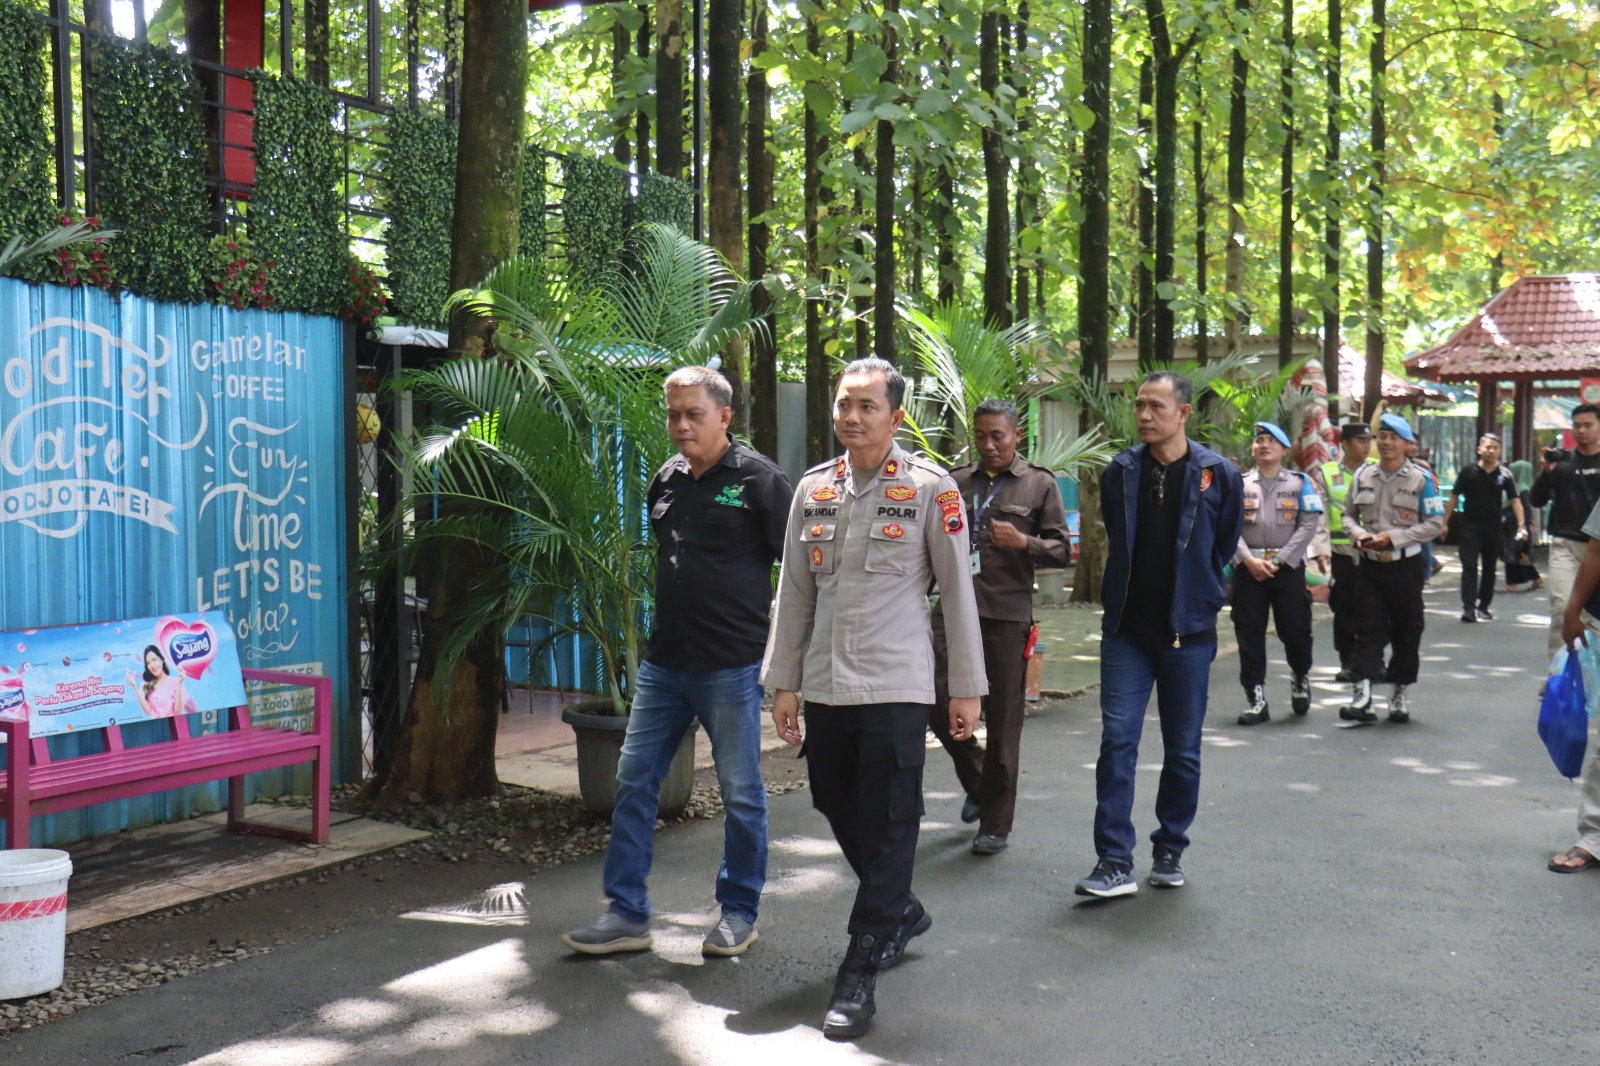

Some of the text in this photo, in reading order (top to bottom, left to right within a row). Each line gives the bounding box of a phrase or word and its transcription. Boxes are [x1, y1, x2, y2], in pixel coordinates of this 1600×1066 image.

[212, 374, 285, 402] COFFEE
[199, 482, 304, 553] Time
[804, 507, 838, 518] ISKANDAR
[877, 506, 916, 519] POLRI
[197, 558, 322, 612] LET'S BE
[172, 636, 210, 659] Sayang
[35, 685, 124, 705] Perlu Dikasih Sayang
[56, 676, 102, 693] Karena Ibu
